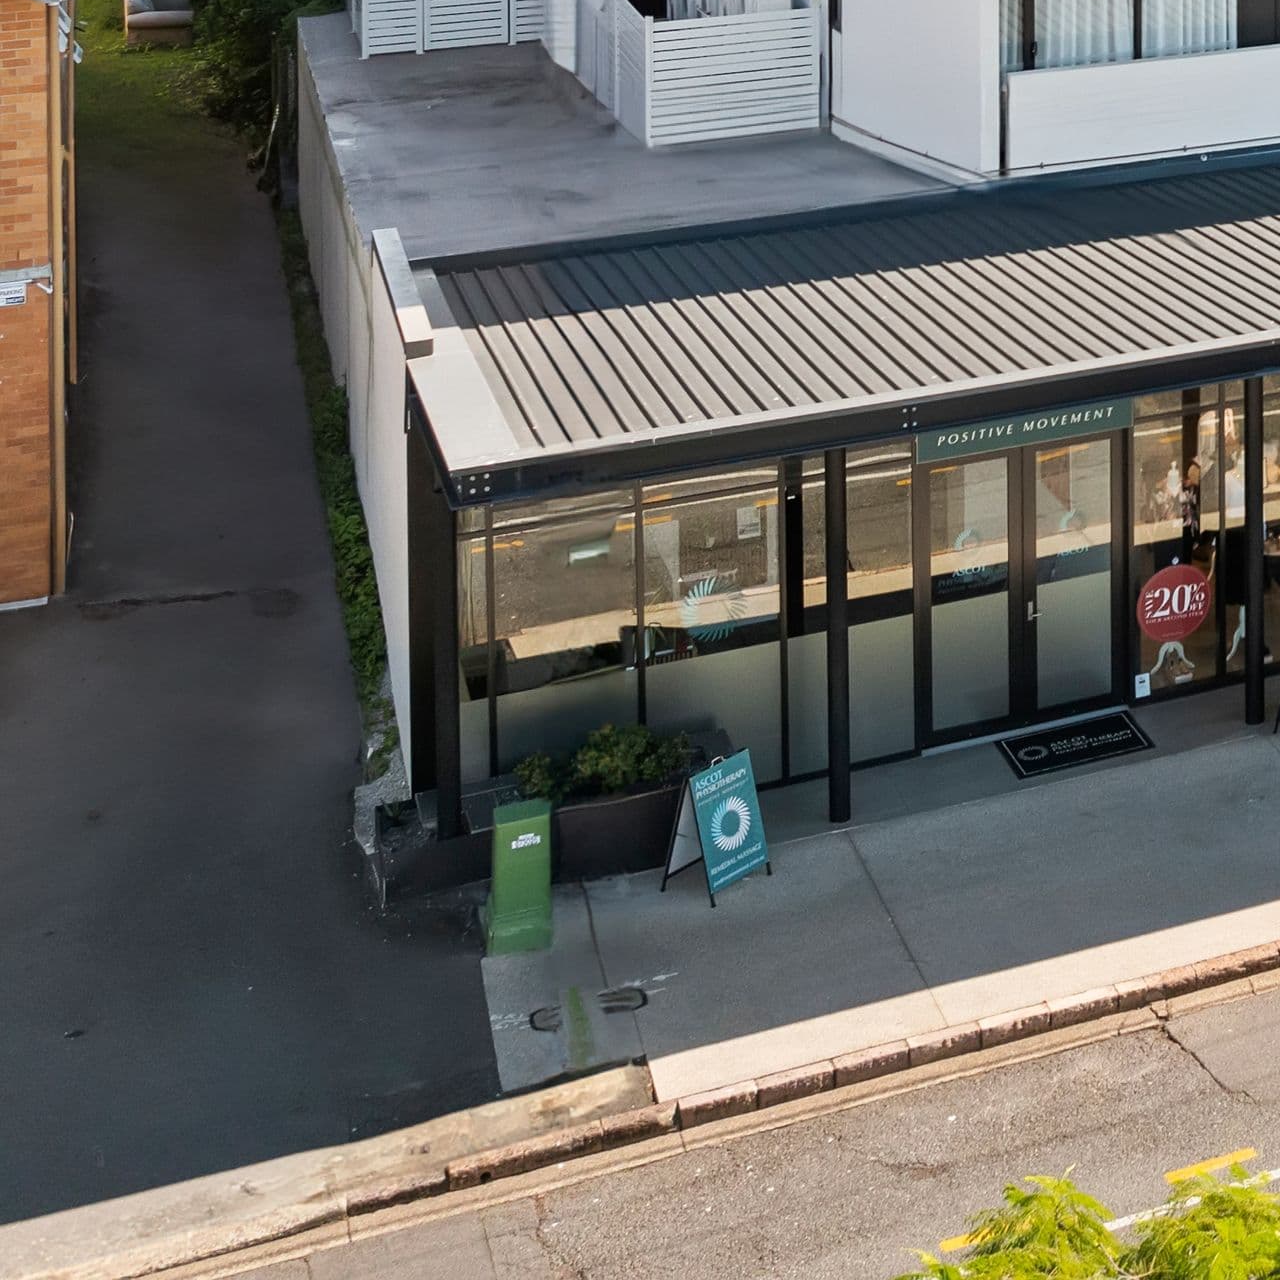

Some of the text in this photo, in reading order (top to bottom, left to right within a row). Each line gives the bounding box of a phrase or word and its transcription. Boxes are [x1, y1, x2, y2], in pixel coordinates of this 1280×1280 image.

[937, 406, 1115, 447] POSITIVE MOVEMENT
[1152, 582, 1206, 618] 20%
[695, 769, 722, 791] ASCOT
[696, 768, 747, 800] PHYSIOTHERAPY
